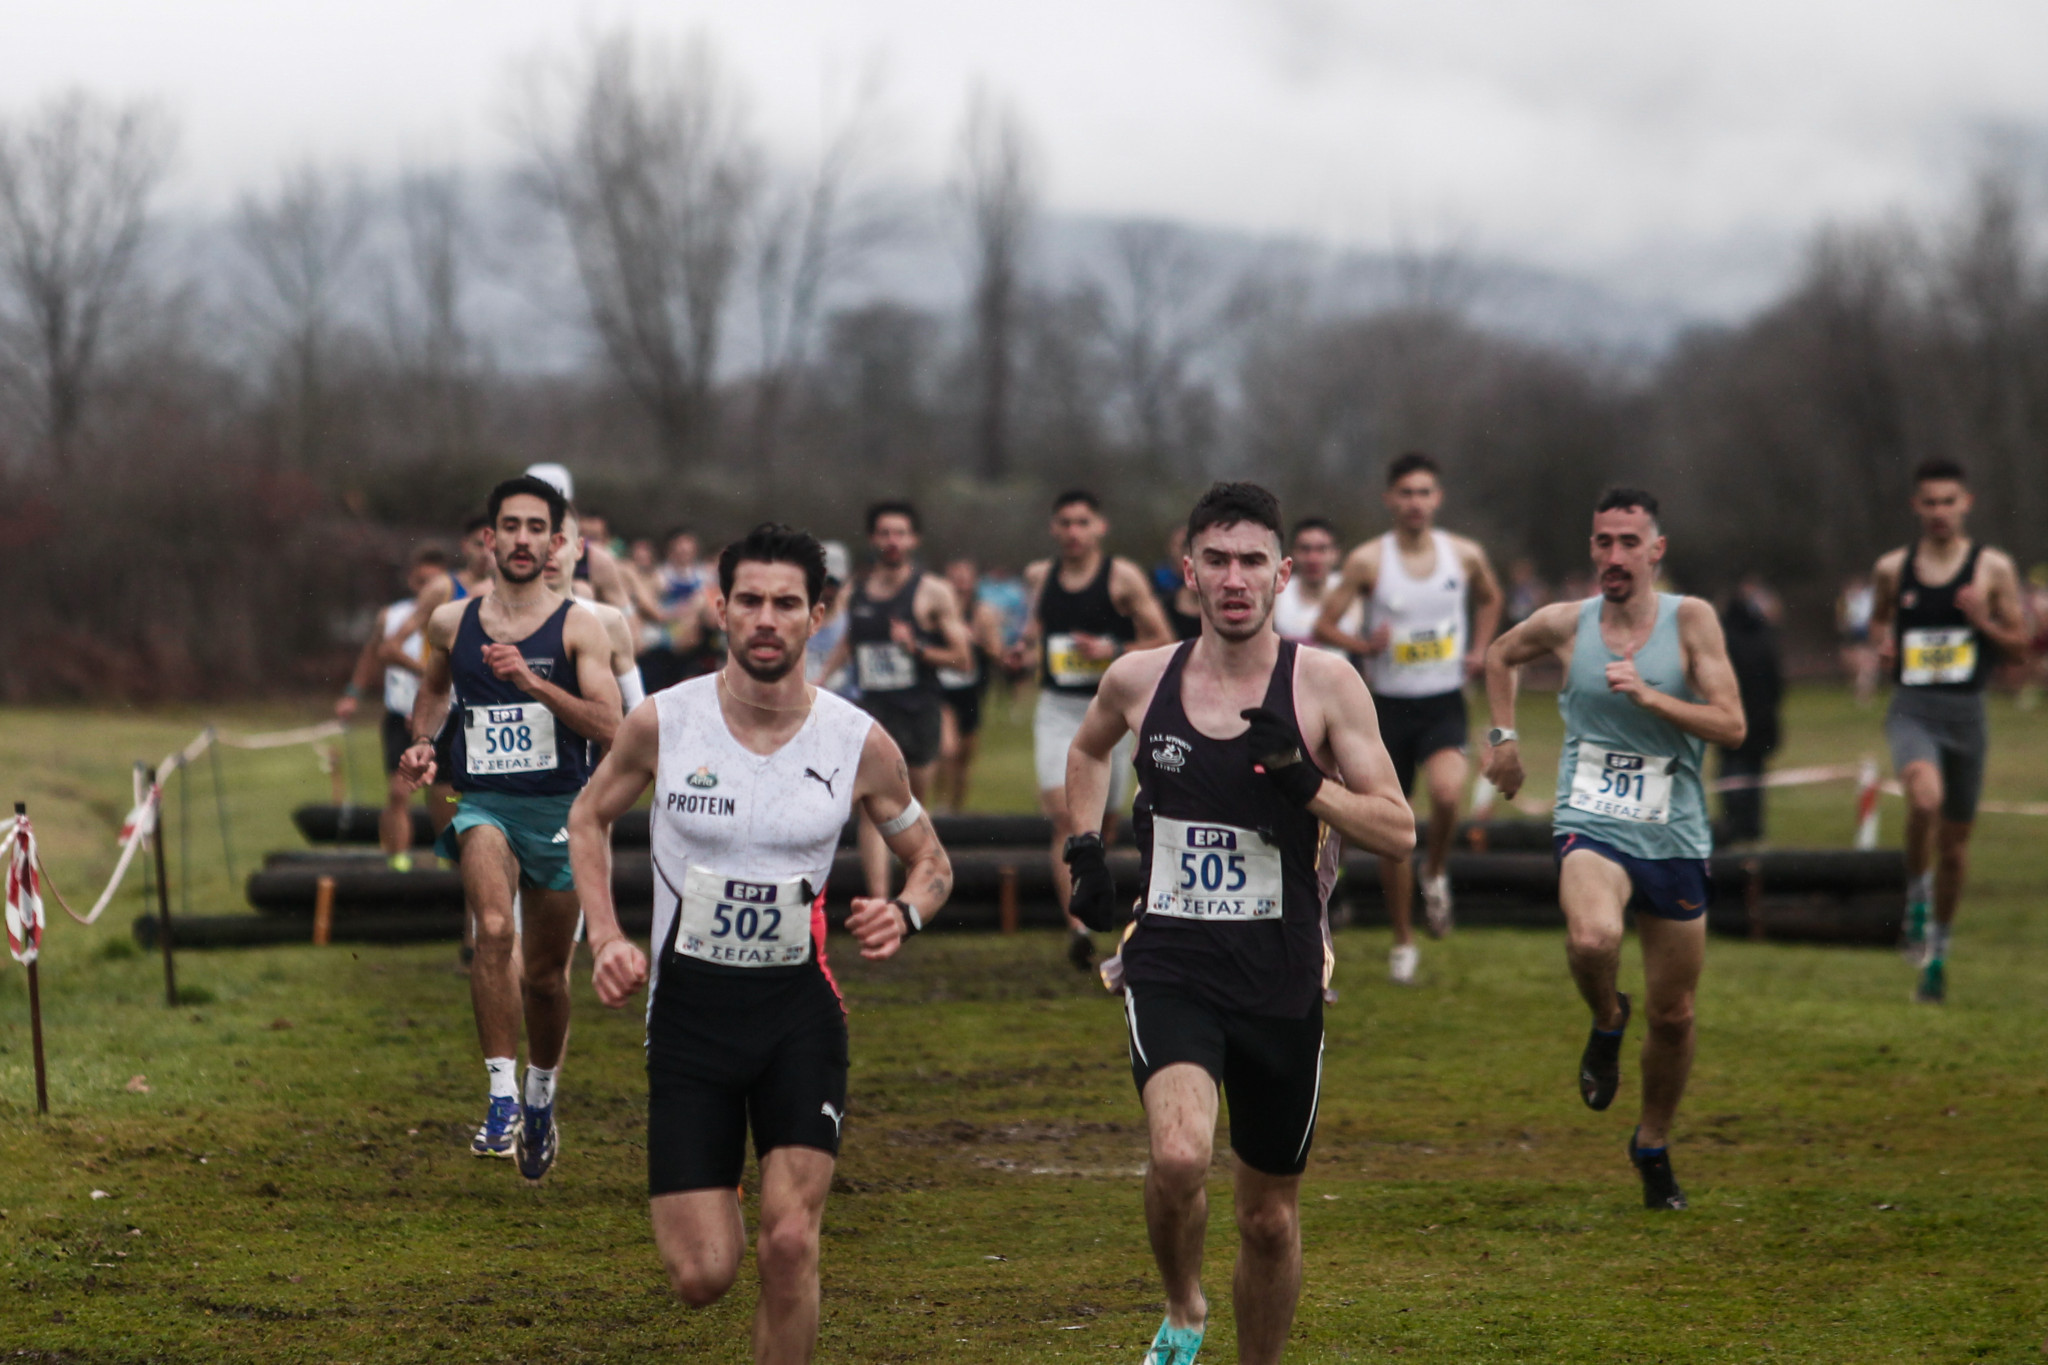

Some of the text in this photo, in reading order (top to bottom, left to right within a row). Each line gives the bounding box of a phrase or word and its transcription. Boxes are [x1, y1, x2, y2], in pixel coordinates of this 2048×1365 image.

[491, 709, 519, 722] ΕΡΤ
[485, 725, 533, 755] 508
[488, 758, 532, 770] ΣΕΓΑΣ
[689, 775, 714, 787] Arla
[1598, 768, 1645, 802] 501
[667, 793, 735, 816] PROTEIN
[1594, 800, 1642, 819] ΣΕΓΑΣ
[1194, 828, 1230, 847] ΕΡΤ
[1180, 852, 1247, 892] 505
[732, 883, 770, 901] ΕΡΤ
[1182, 899, 1246, 915] ΣΕΓΑΣ
[710, 902, 782, 942] 502
[711, 945, 777, 962] ΣΕΓΑΣ
